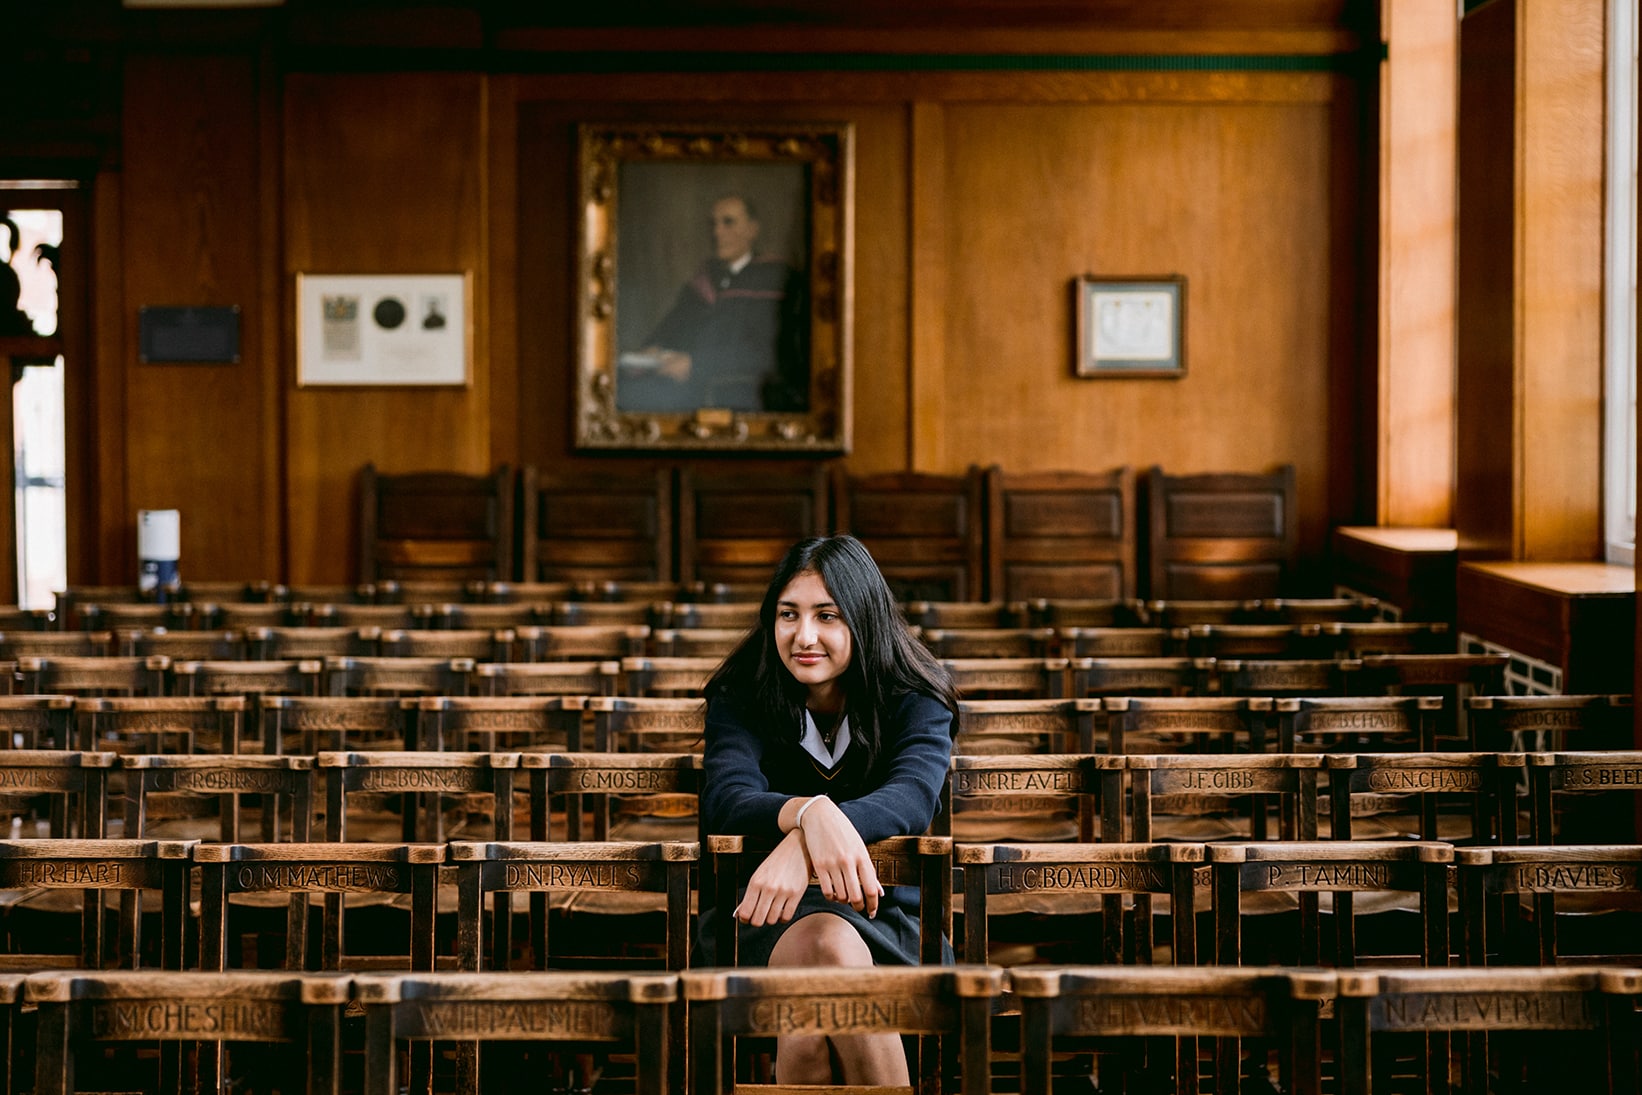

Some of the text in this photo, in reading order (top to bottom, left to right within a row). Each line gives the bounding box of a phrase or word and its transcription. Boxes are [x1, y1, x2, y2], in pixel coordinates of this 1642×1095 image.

[581, 771, 660, 790] C.MOSER
[1183, 772, 1254, 790] J.F.GIBB
[20, 863, 125, 885] H.R.HART
[238, 865, 400, 889] O.M.MATHEWS
[505, 864, 641, 888] D.N.RYALLS
[998, 866, 1165, 890] H.C.BOARDMAN
[1296, 865, 1389, 887] TAMINI
[1519, 866, 1625, 888] I.DAVIES
